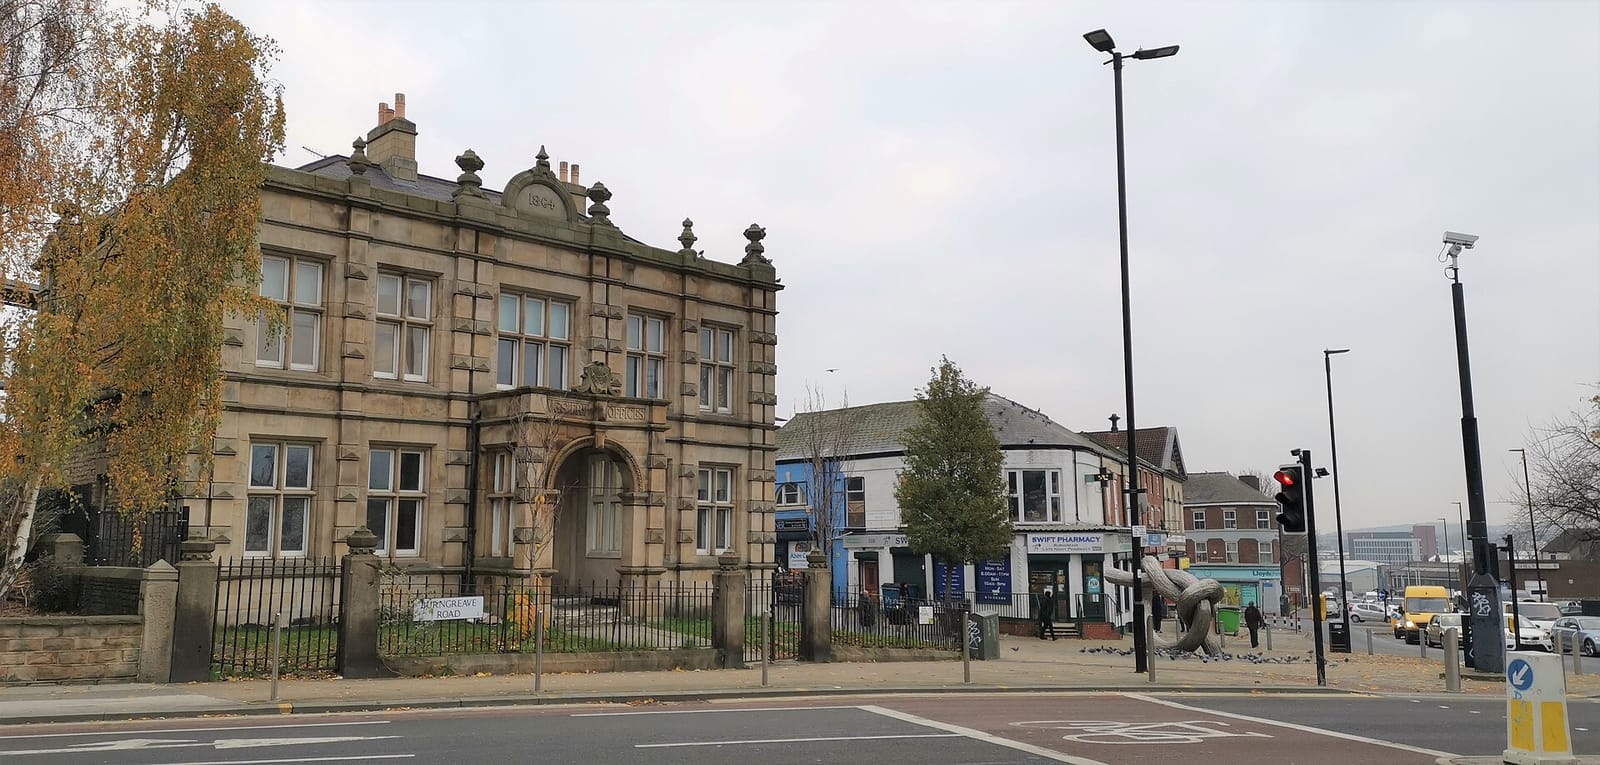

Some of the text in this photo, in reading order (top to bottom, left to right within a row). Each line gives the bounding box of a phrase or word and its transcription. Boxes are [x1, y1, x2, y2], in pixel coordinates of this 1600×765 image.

[607, 406, 646, 421] OFFICES
[895, 536, 908, 544] SW
[437, 610, 461, 618] ROAD
